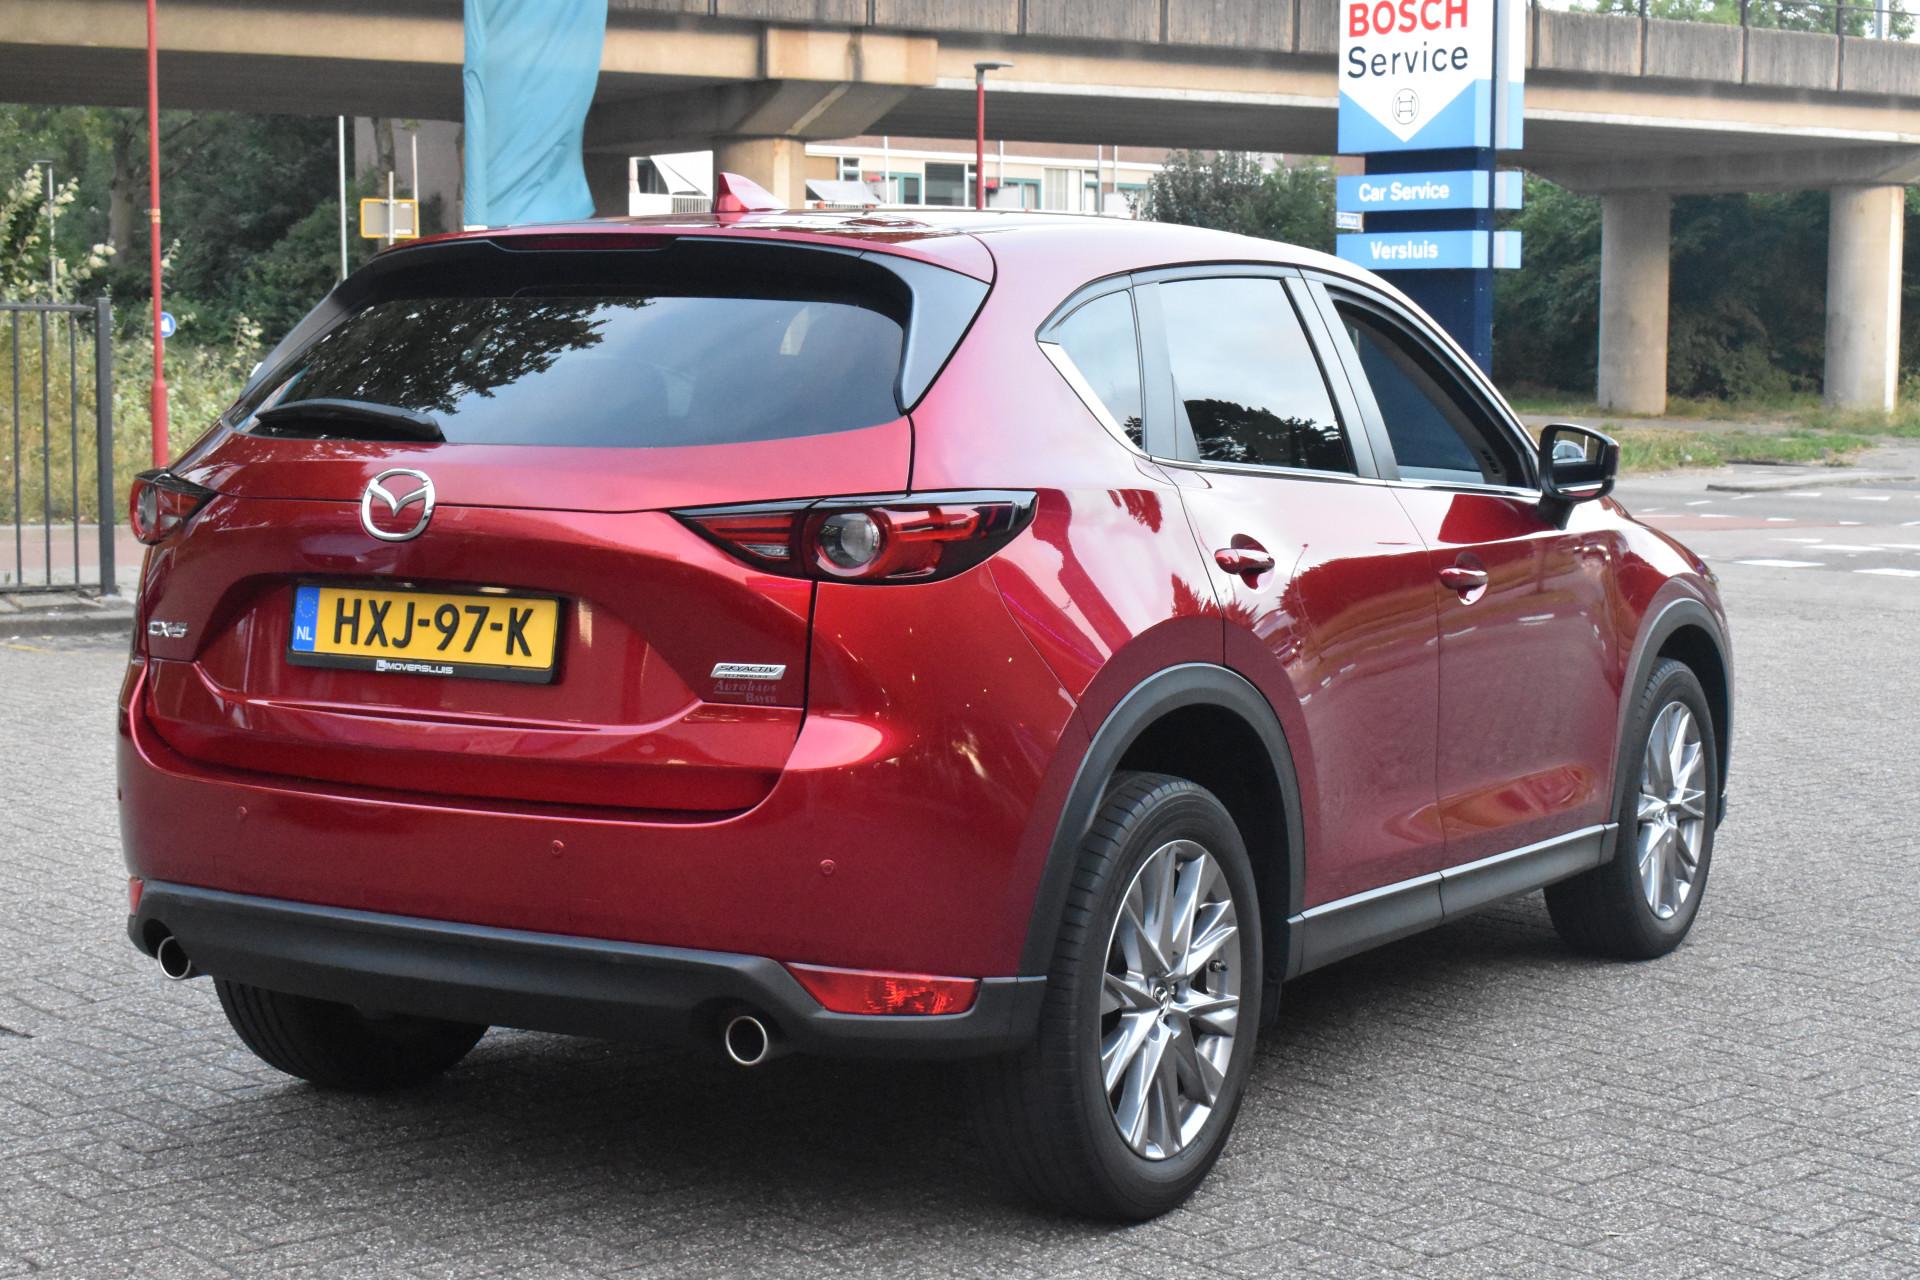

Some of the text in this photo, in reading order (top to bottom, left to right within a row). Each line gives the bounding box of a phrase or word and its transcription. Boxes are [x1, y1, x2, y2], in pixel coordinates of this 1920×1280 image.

[1349, 0, 1468, 37] BOSCH
[1347, 41, 1468, 78] Service
[1359, 181, 1449, 201] Car Service
[1370, 241, 1438, 259] Versluis
[296, 626, 312, 641] NL
[333, 598, 533, 656] HXJ-97-K
[719, 665, 777, 673] SKYACTIV
